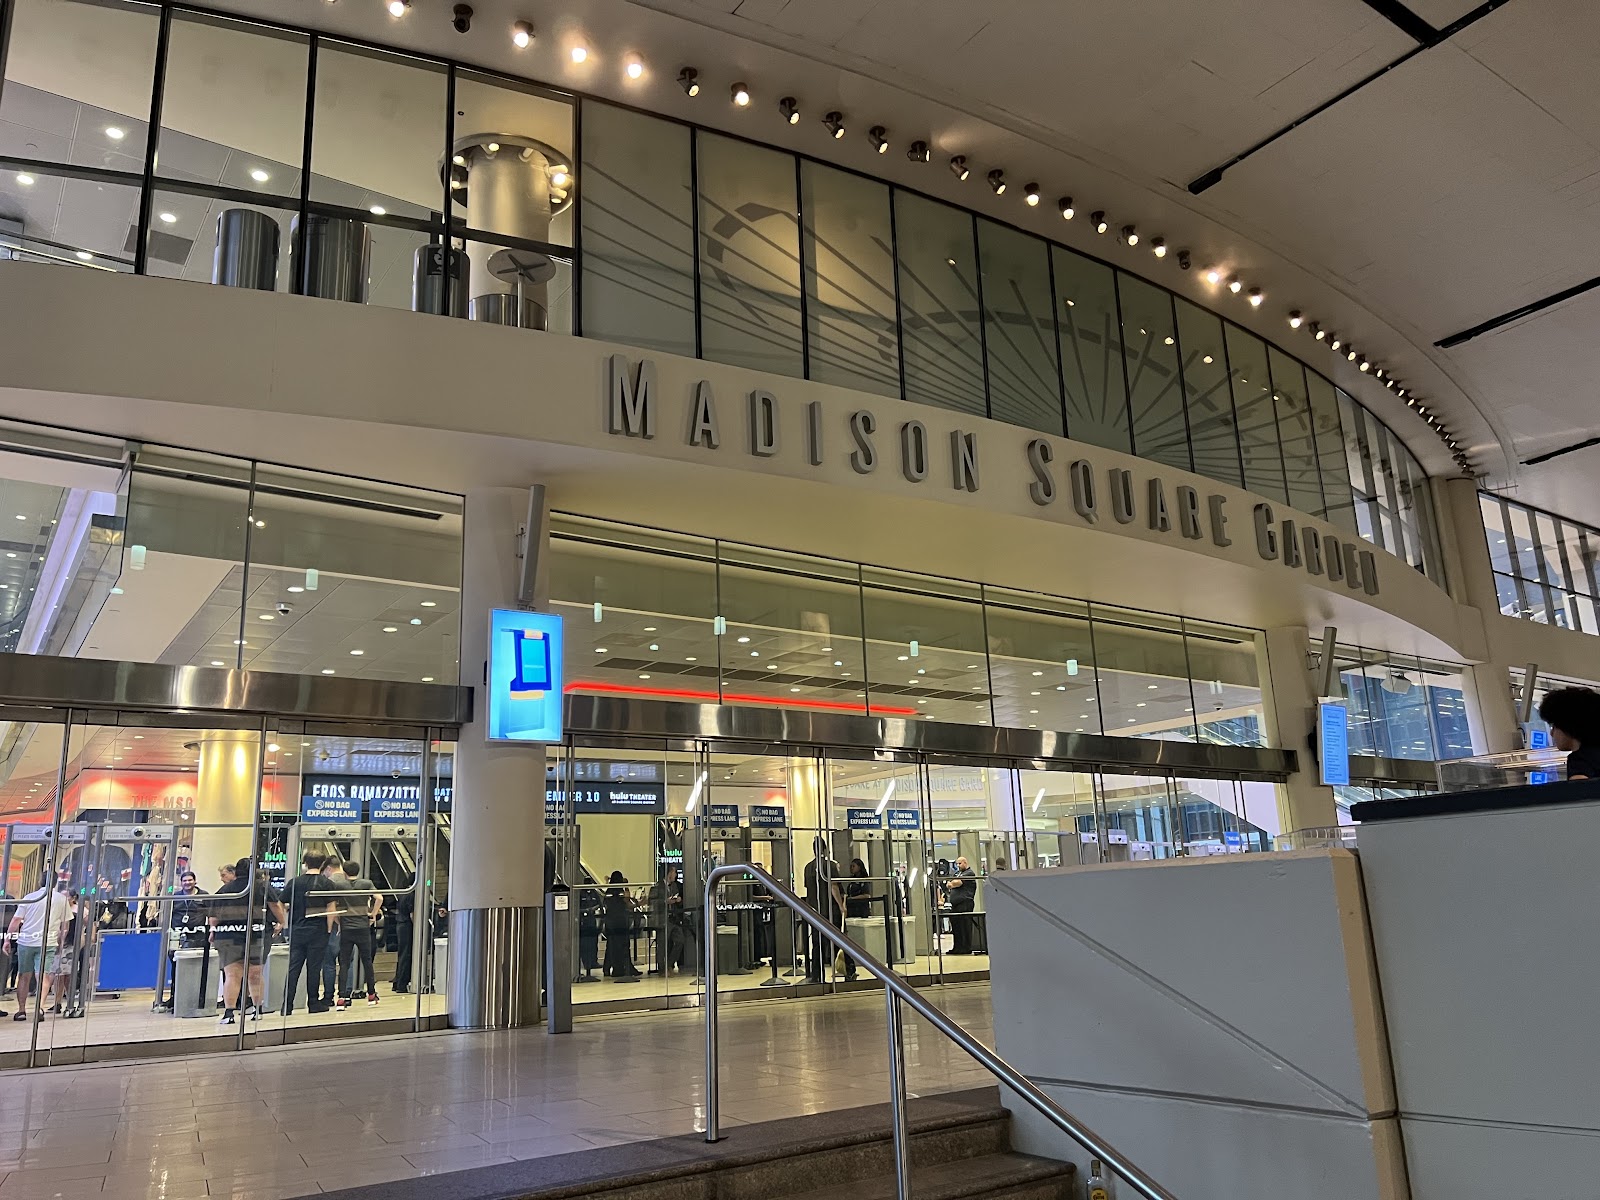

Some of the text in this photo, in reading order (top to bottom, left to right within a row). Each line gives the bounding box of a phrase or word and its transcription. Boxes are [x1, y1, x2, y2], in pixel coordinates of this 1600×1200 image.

[609, 354, 1380, 596] MADISON SQUARE GARDEN
[586, 791, 600, 803] 10
[609, 791, 657, 801] hulu THEATER
[336, 801, 350, 809] BAG
[307, 810, 357, 818] EXPRESS LANE
[374, 810, 404, 818] EXPRESS
